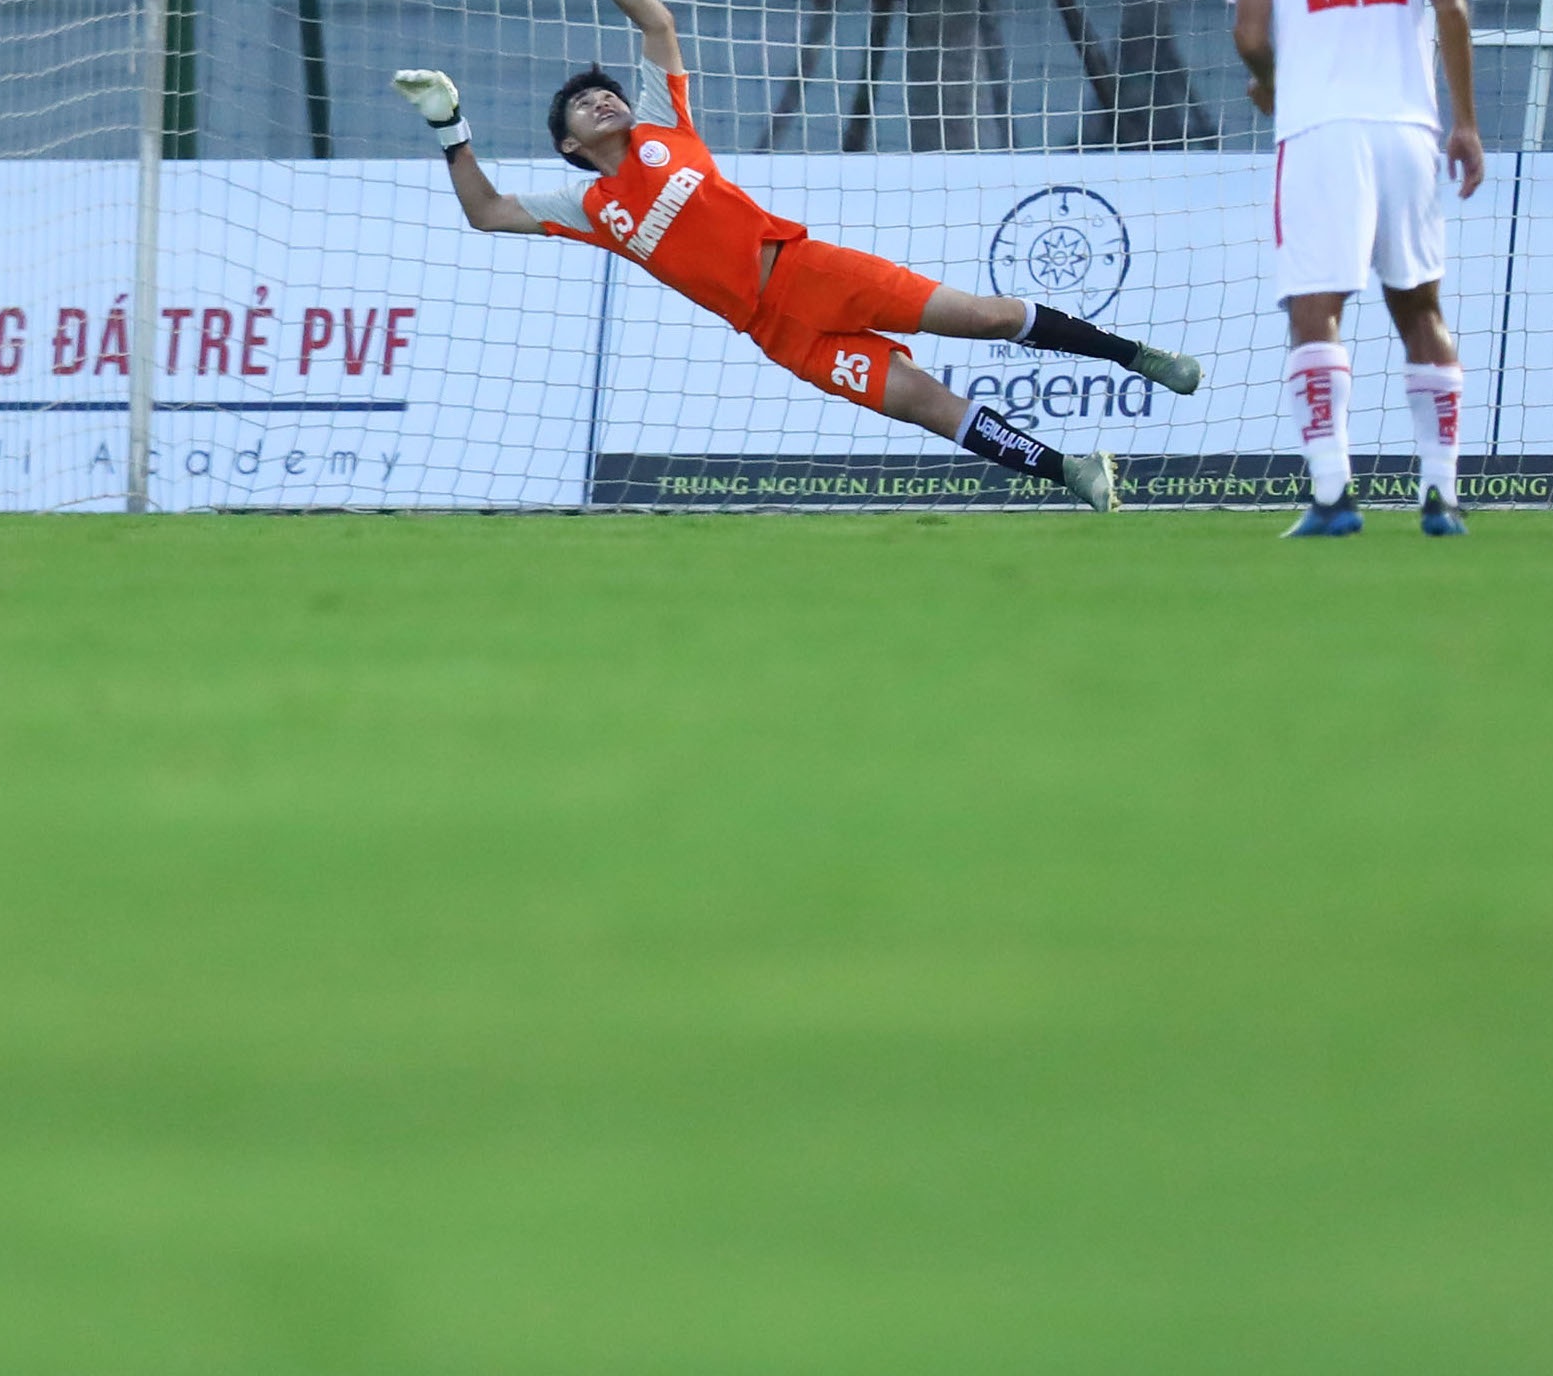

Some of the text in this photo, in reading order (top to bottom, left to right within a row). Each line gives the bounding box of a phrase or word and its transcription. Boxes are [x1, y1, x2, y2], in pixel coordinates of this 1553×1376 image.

[599, 200, 635, 242] 25
[52, 293, 130, 376] ĐÁ
[162, 285, 273, 376] TRẺ
[299, 308, 416, 376] PVF
[830, 349, 872, 393] 25
[657, 476, 750, 496] TRUNG
[757, 473, 869, 497] NGUYÊN
[877, 477, 982, 497] LEGEND
[1148, 473, 1256, 497] CHUYÊN
[1266, 472, 1299, 496] CÀ
